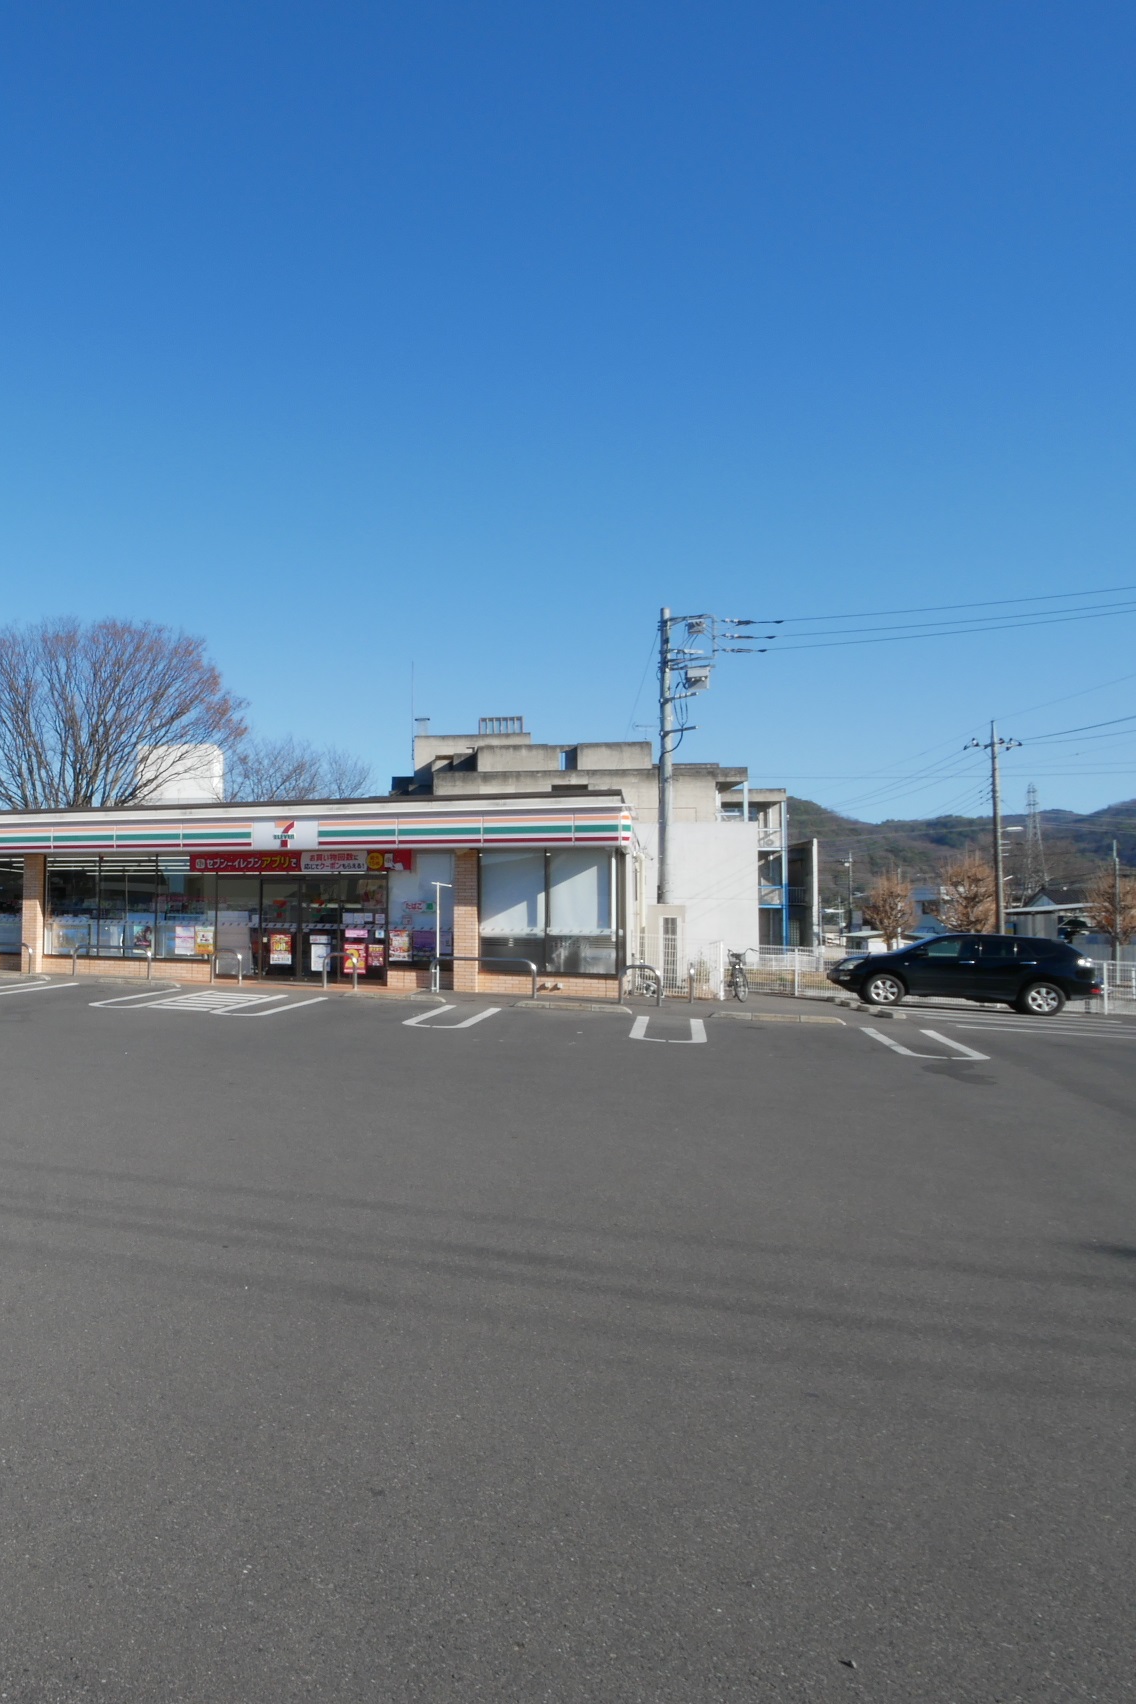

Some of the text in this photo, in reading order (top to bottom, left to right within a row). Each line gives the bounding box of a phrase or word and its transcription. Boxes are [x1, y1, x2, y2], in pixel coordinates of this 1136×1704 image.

[275, 820, 295, 848] 7
[309, 853, 359, 862] お買い物回数に
